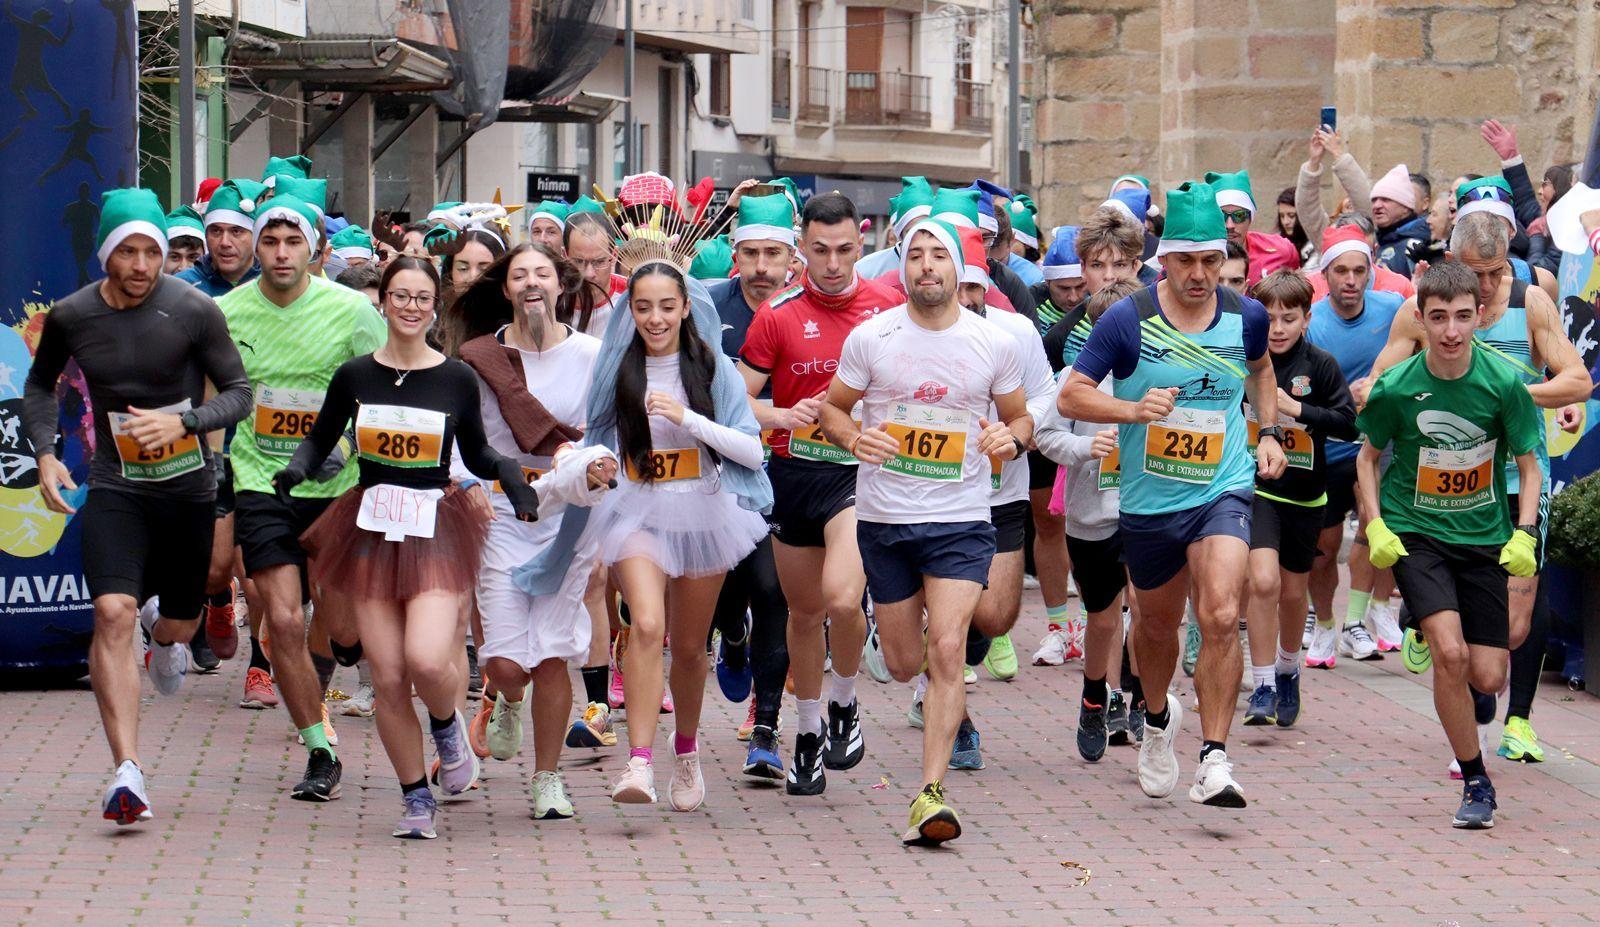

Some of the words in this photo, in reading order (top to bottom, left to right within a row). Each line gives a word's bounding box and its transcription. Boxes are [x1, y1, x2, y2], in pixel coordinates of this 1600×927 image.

[537, 177, 570, 191] himm
[272, 411, 314, 436] 296
[274, 441, 283, 449] DE
[376, 432, 420, 459] 286
[793, 443, 810, 454] JUNTA
[812, 446, 821, 456] DE
[904, 430, 949, 459] 167
[1163, 431, 1208, 461] 234
[128, 465, 144, 475] JUNTA
[145, 467, 153, 475] DE
[155, 455, 200, 475] EXTREMADURA
[651, 453, 680, 479] 87
[885, 459, 903, 469] JUNTA
[905, 462, 913, 471] DE
[914, 463, 959, 477] EXTREMADURA
[1148, 459, 1165, 471] JUNTA
[1167, 463, 1175, 473] DE
[1177, 465, 1216, 477] EXTREMADUR
[1101, 476, 1114, 485] JUNTA
[1436, 469, 1479, 494] 390
[373, 487, 429, 527] BUEY
[1419, 495, 1438, 506] JUNTA
[1440, 499, 1449, 507] DE
[1450, 491, 1490, 507] EXTREMADURA
[5, 605, 59, 615] Ayuntamiento
[59, 604, 68, 612] de
